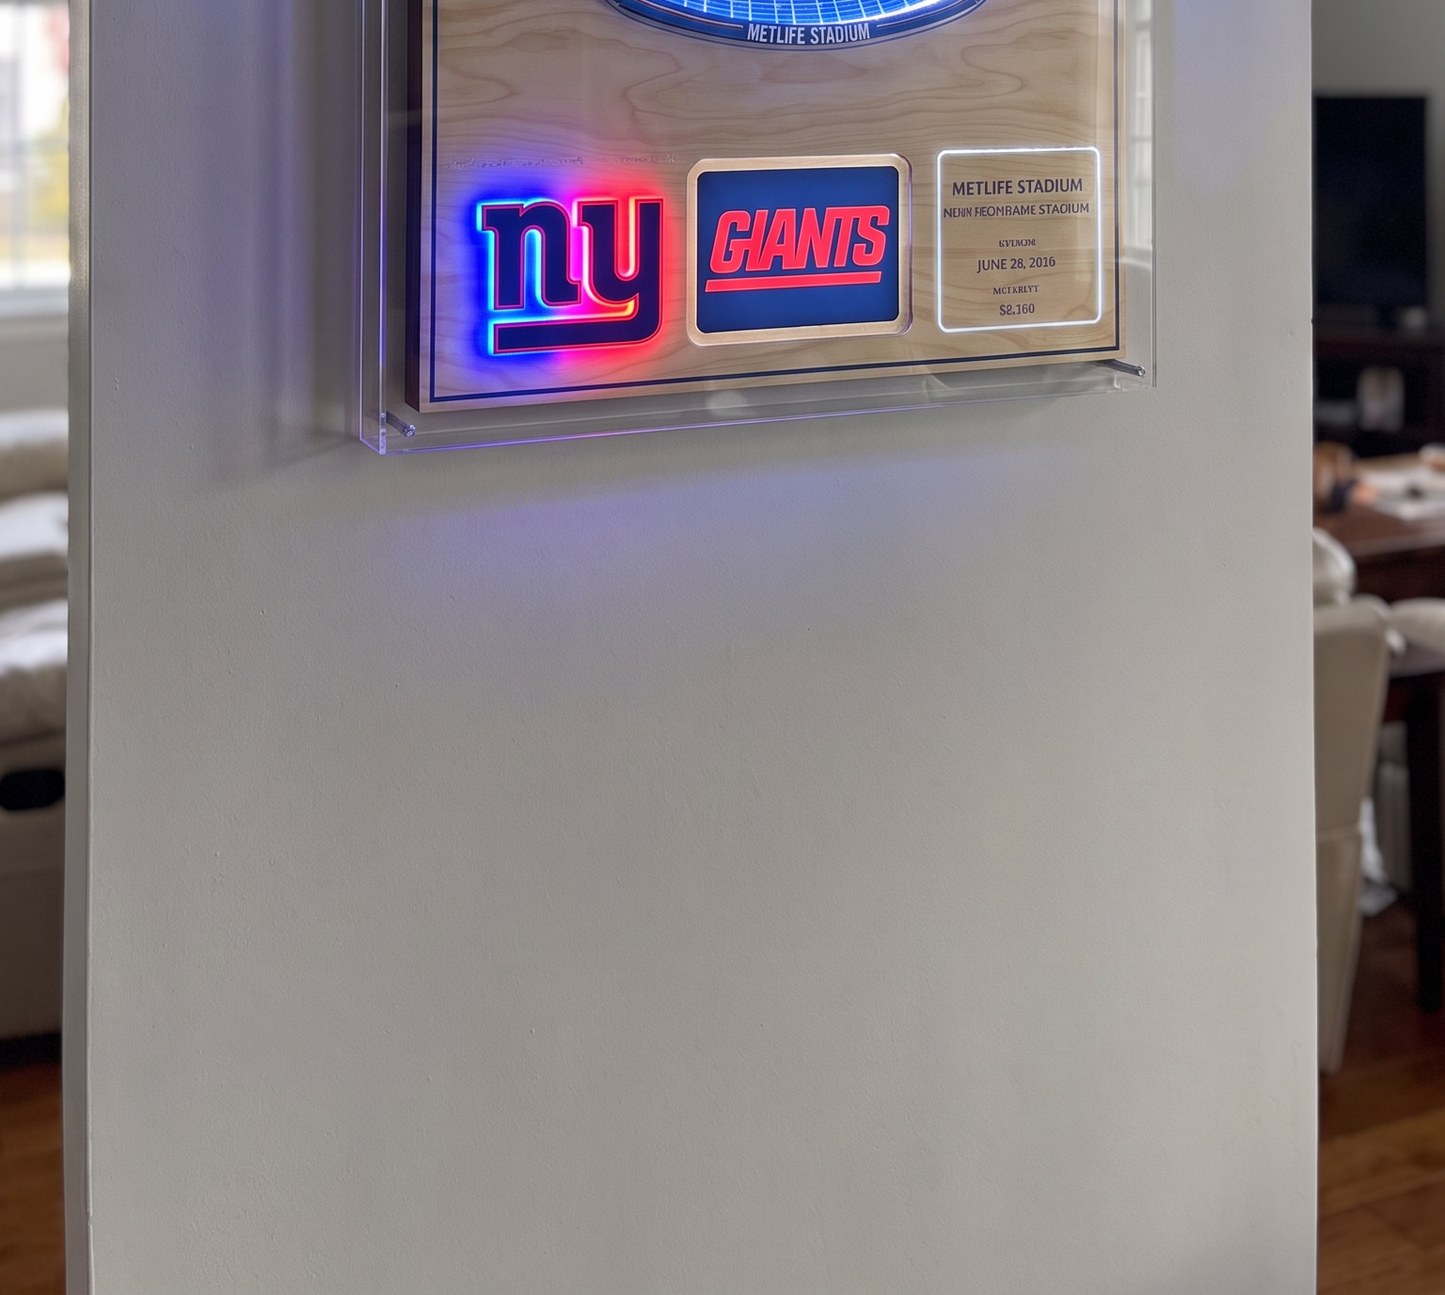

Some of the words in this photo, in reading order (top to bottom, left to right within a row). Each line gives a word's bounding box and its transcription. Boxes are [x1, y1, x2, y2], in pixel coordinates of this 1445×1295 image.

[747, 23, 806, 45] METLIFE
[810, 22, 870, 45] STADIUM
[952, 181, 1013, 196] METLIFE
[1017, 178, 1083, 194] STADIUM
[709, 205, 890, 274] GIANTS
[976, 258, 1007, 274] JUNE
[1010, 257, 1026, 270] 28,
[1029, 256, 1056, 269] 2016
